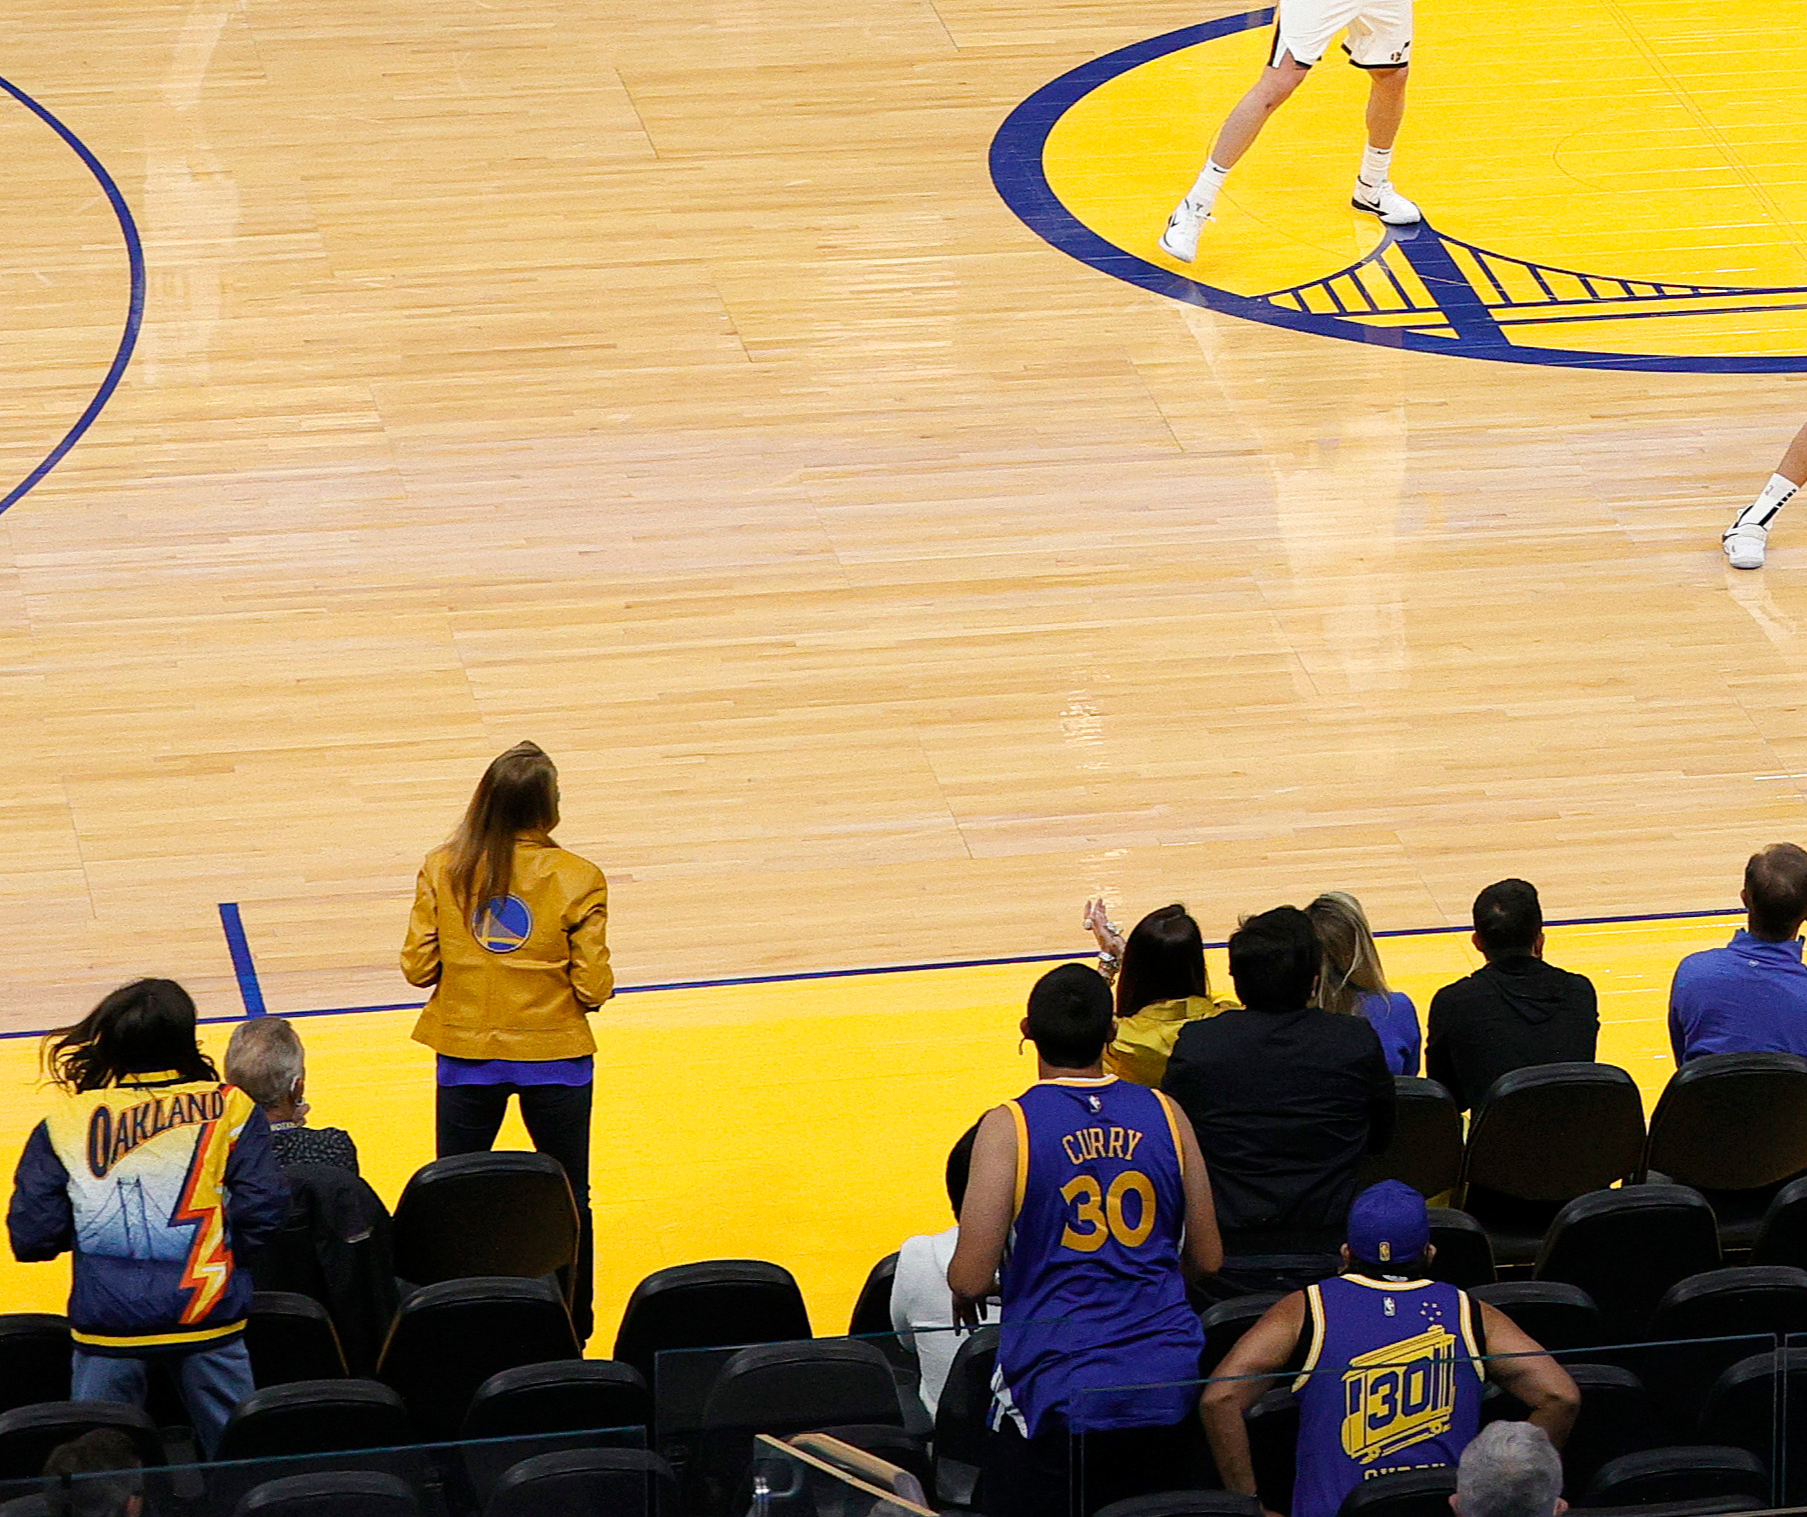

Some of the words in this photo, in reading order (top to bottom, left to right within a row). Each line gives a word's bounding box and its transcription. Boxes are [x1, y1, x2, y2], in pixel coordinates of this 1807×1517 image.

[87, 1089, 226, 1179] OAKLAND
[1061, 1126, 1144, 1166] CURRY
[1059, 1170, 1157, 1252] 30
[1367, 1357, 1431, 1432] 30
